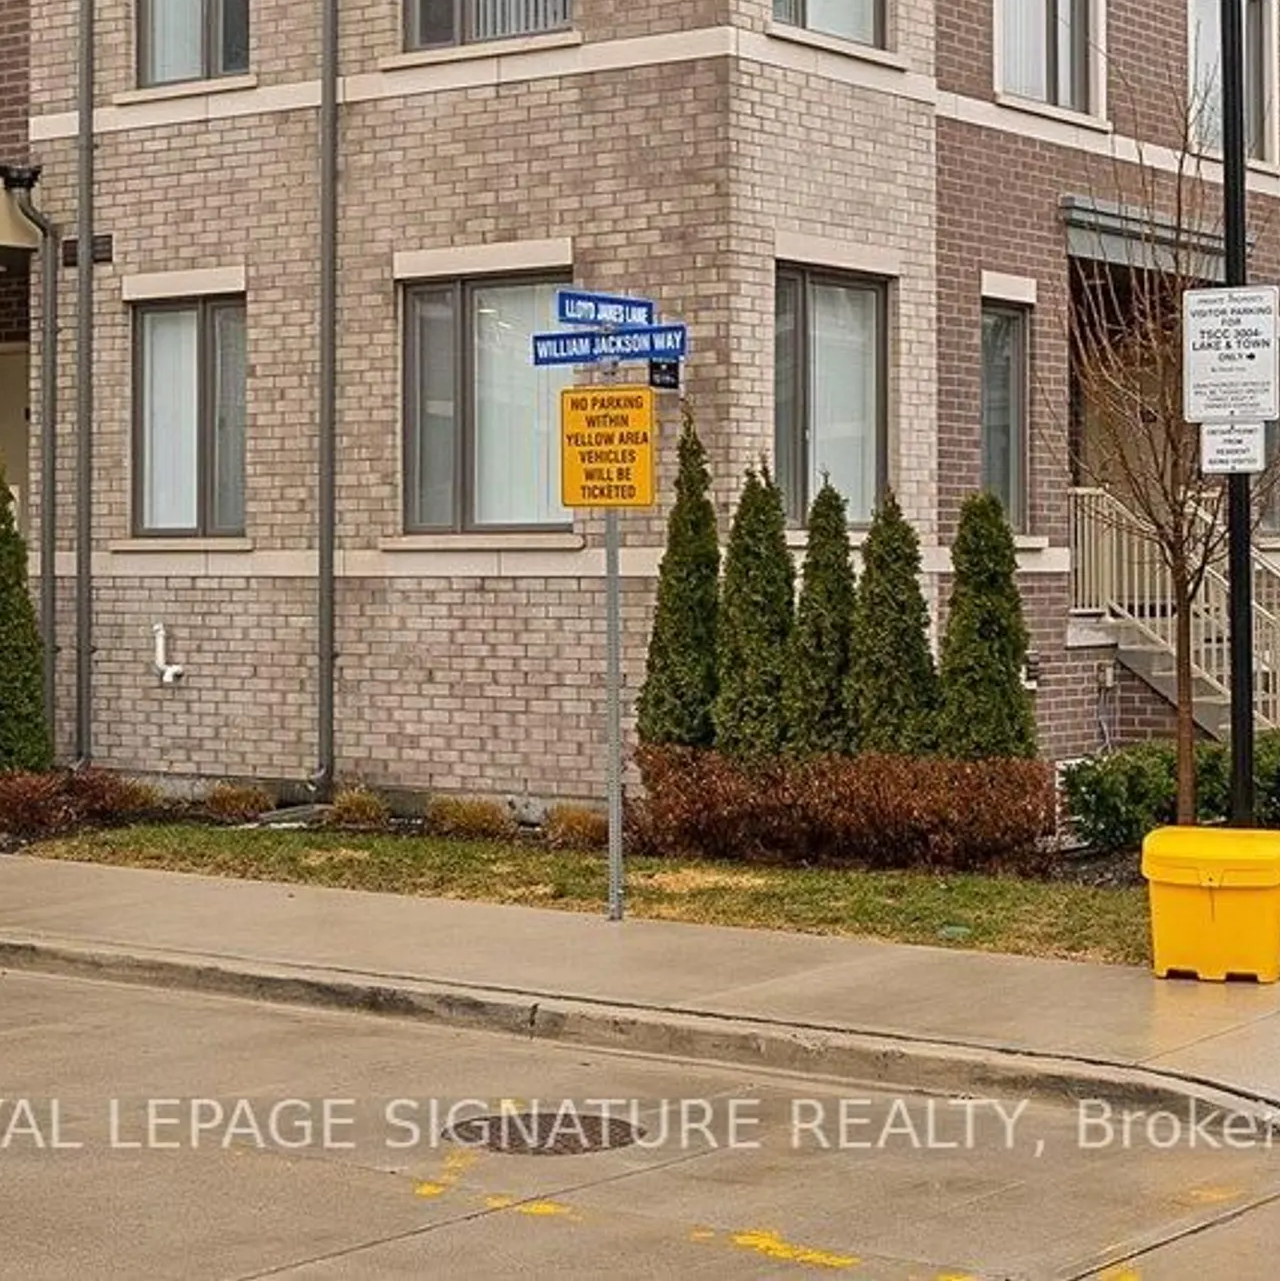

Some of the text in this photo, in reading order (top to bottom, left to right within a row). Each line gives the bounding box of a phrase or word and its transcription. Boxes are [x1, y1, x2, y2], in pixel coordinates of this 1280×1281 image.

[564, 298, 595, 319] LLOYD
[625, 305, 649, 325] LANE
[1190, 306, 1272, 318] VISITOR PARKING
[1221, 318, 1241, 327] FOR
[1200, 329, 1229, 339] TSCC
[537, 330, 682, 358] WILLIAM JACKSON WAY
[1192, 338, 1271, 351] LAKE & TOWN
[1219, 352, 1244, 362] ONLY
[569, 396, 644, 411] NO PARKING
[585, 414, 629, 428] WITHIN
[566, 431, 648, 447] YELLOW AREA
[578, 449, 636, 464] VEHICLES
[584, 466, 631, 481] WILL BE
[580, 484, 636, 499] TICKETED
